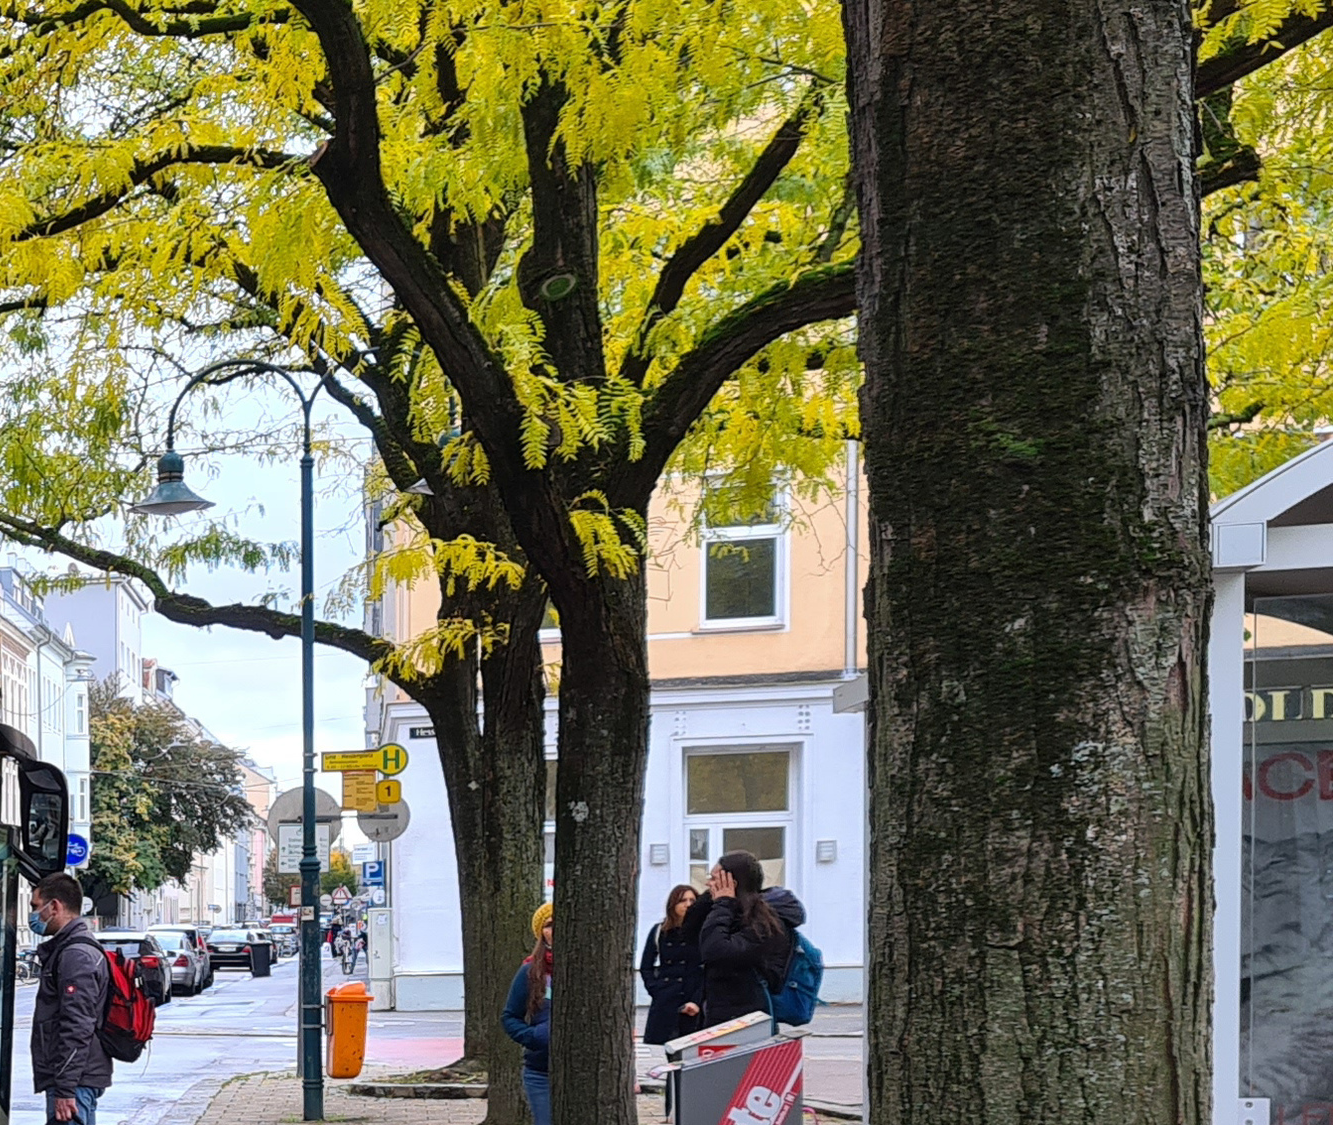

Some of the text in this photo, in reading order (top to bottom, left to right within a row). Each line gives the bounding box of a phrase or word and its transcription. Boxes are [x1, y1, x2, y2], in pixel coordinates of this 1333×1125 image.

[383, 750, 400, 770] H
[385, 785, 392, 797] 1
[365, 863, 380, 878] P
